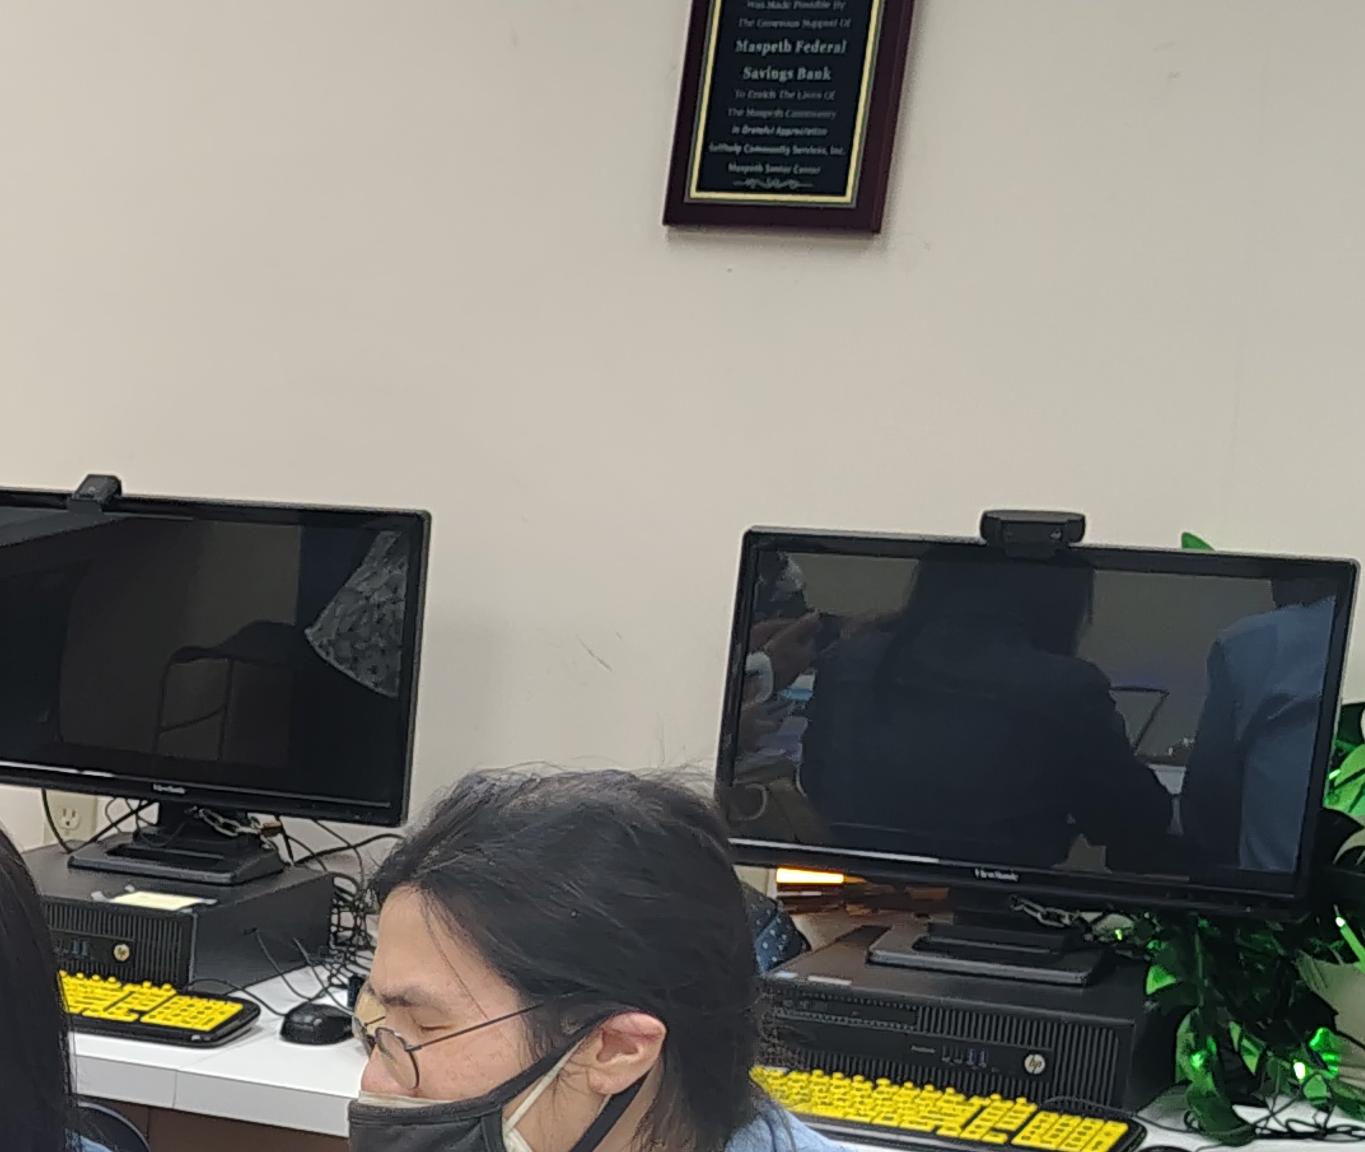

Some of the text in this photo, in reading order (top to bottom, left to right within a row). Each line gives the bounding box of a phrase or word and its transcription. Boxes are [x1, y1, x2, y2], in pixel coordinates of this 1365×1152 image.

[735, 39, 847, 56] Maspeth Federal
[742, 65, 832, 83] Savings Bank
